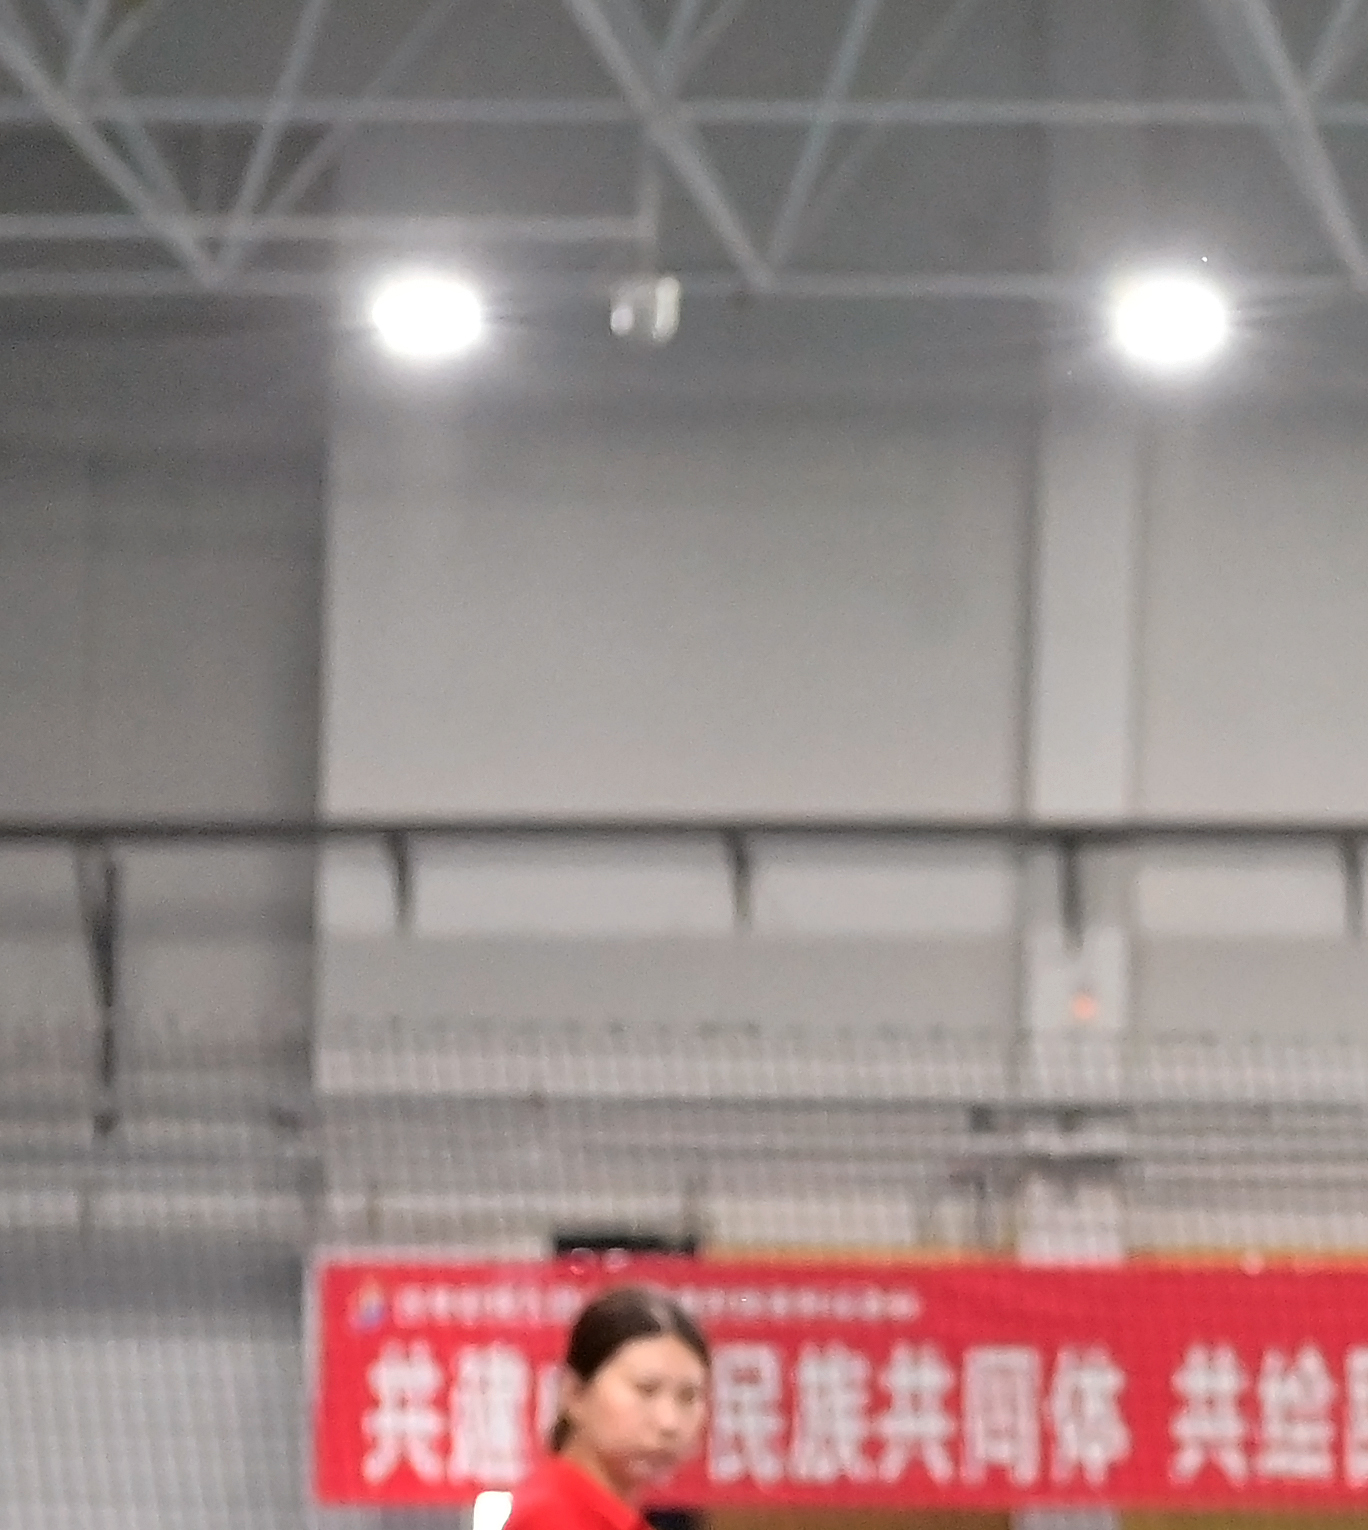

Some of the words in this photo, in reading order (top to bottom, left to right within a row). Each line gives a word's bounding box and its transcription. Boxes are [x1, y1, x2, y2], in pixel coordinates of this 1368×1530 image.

[363, 1340, 1131, 1486] 共建民族共同体
